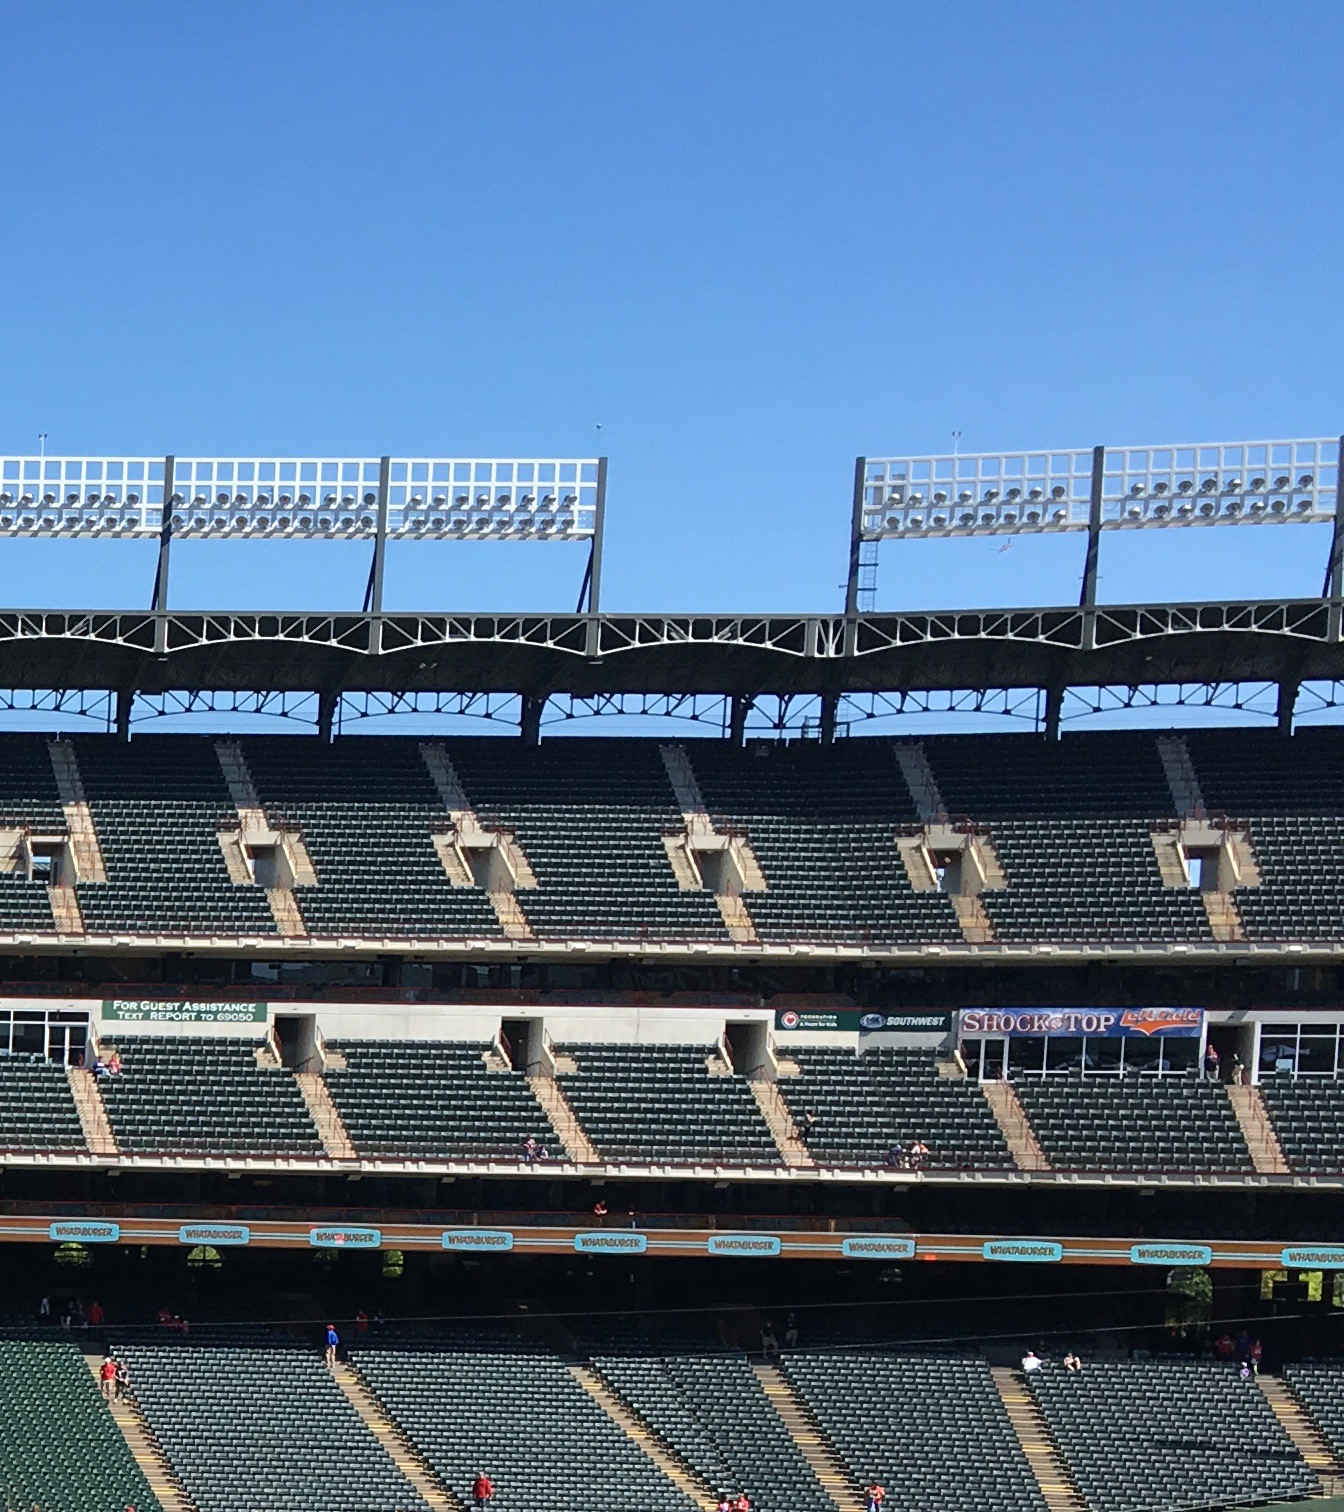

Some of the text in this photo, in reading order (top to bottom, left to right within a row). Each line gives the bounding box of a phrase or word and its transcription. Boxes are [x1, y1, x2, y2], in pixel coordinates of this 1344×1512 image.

[113, 1000, 256, 1012] FOR GUEST ASSISTANCE
[117, 1011, 143, 1020] TEXT
[149, 1012, 197, 1021] REPORT
[216, 1013, 254, 1021] 69050
[886, 1016, 946, 1026] SOUTHWEST
[963, 1012, 1115, 1032] SHOCK TOP
[56, 1226, 113, 1237] WHATABURGER
[185, 1229, 243, 1240] WHATABURGER
[316, 1232, 375, 1243] WHATABURGER
[448, 1234, 506, 1246] WHATABURGER
[580, 1237, 640, 1248] WHATABURGER
[714, 1239, 774, 1250] WHATABURGER
[849, 1242, 909, 1253] WHATABURGER
[990, 1245, 1054, 1257] WHATABURGER
[1137, 1248, 1205, 1260] WHATABURGER
